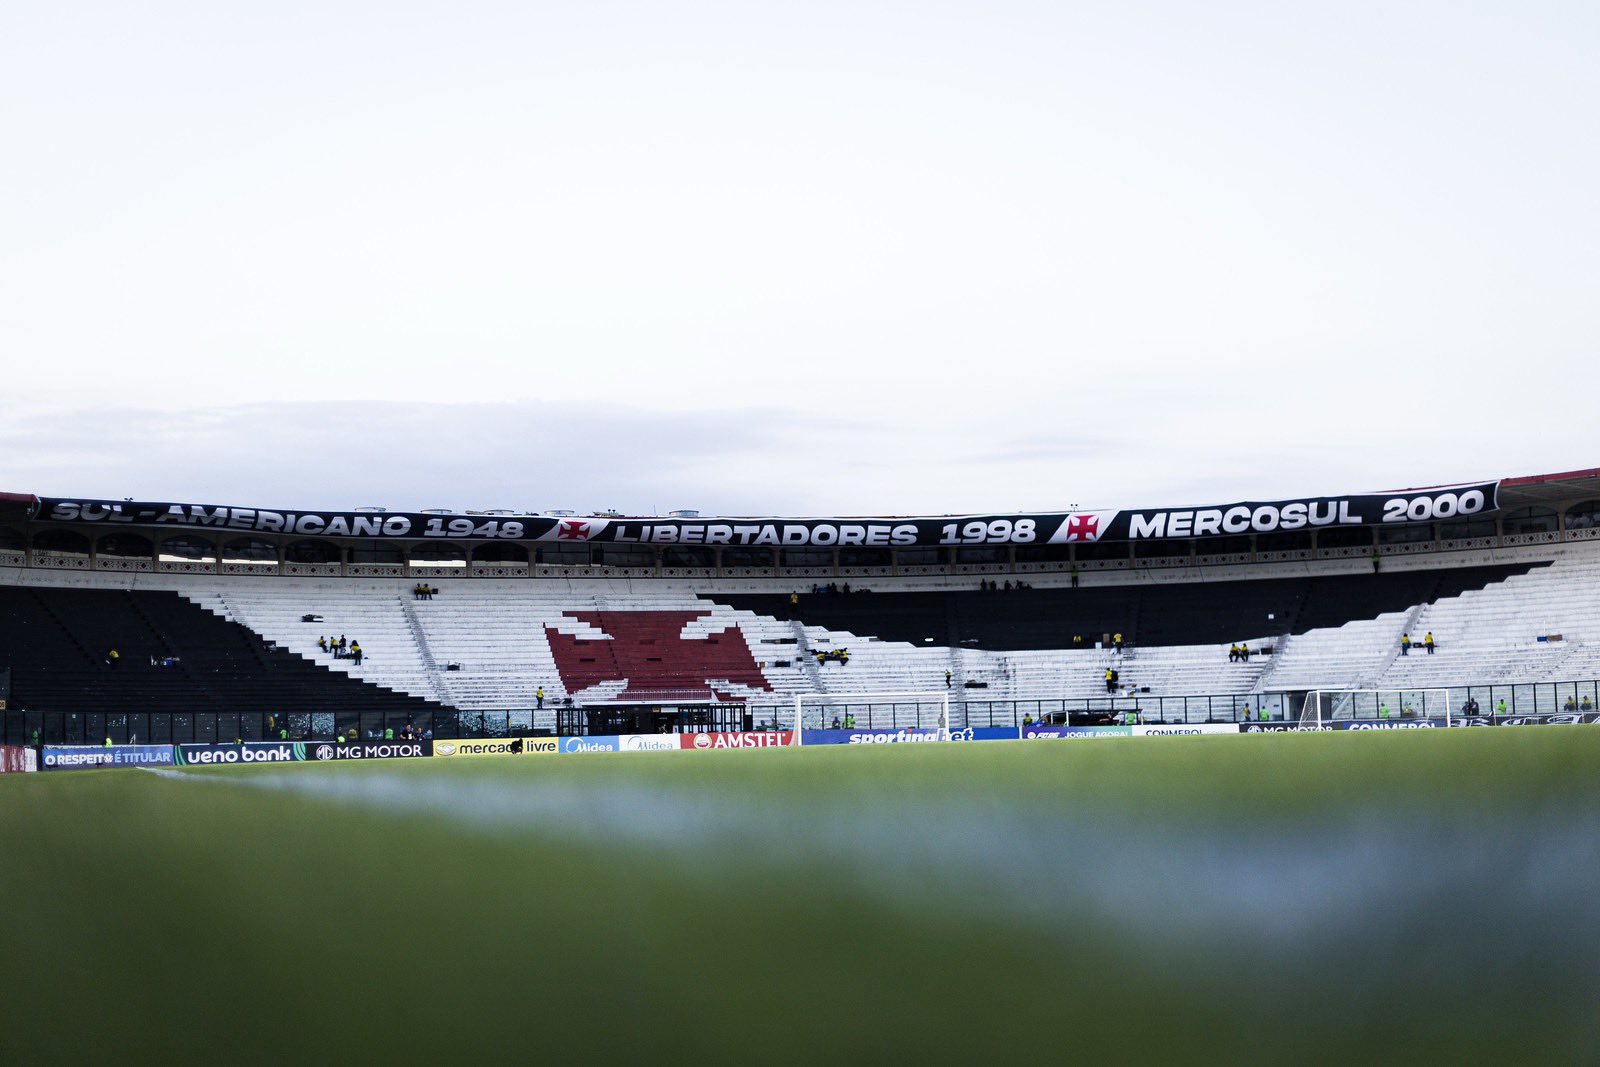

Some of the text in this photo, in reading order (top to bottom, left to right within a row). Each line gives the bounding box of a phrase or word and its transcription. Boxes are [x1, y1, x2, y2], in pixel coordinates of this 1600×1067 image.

[1129, 490, 1484, 538] MERCOSUL 2000
[424, 518, 524, 538] 1948
[614, 519, 1036, 545] LIBERTADORES 1998
[526, 740, 556, 752] livre
[574, 740, 613, 753] Midea
[714, 732, 786, 748] AMSTEL
[45, 754, 56, 765] O
[114, 750, 121, 763] É
[123, 752, 171, 763] TITULAR
[187, 745, 291, 763] ueno bank
[337, 744, 422, 758] MG MOTOR
